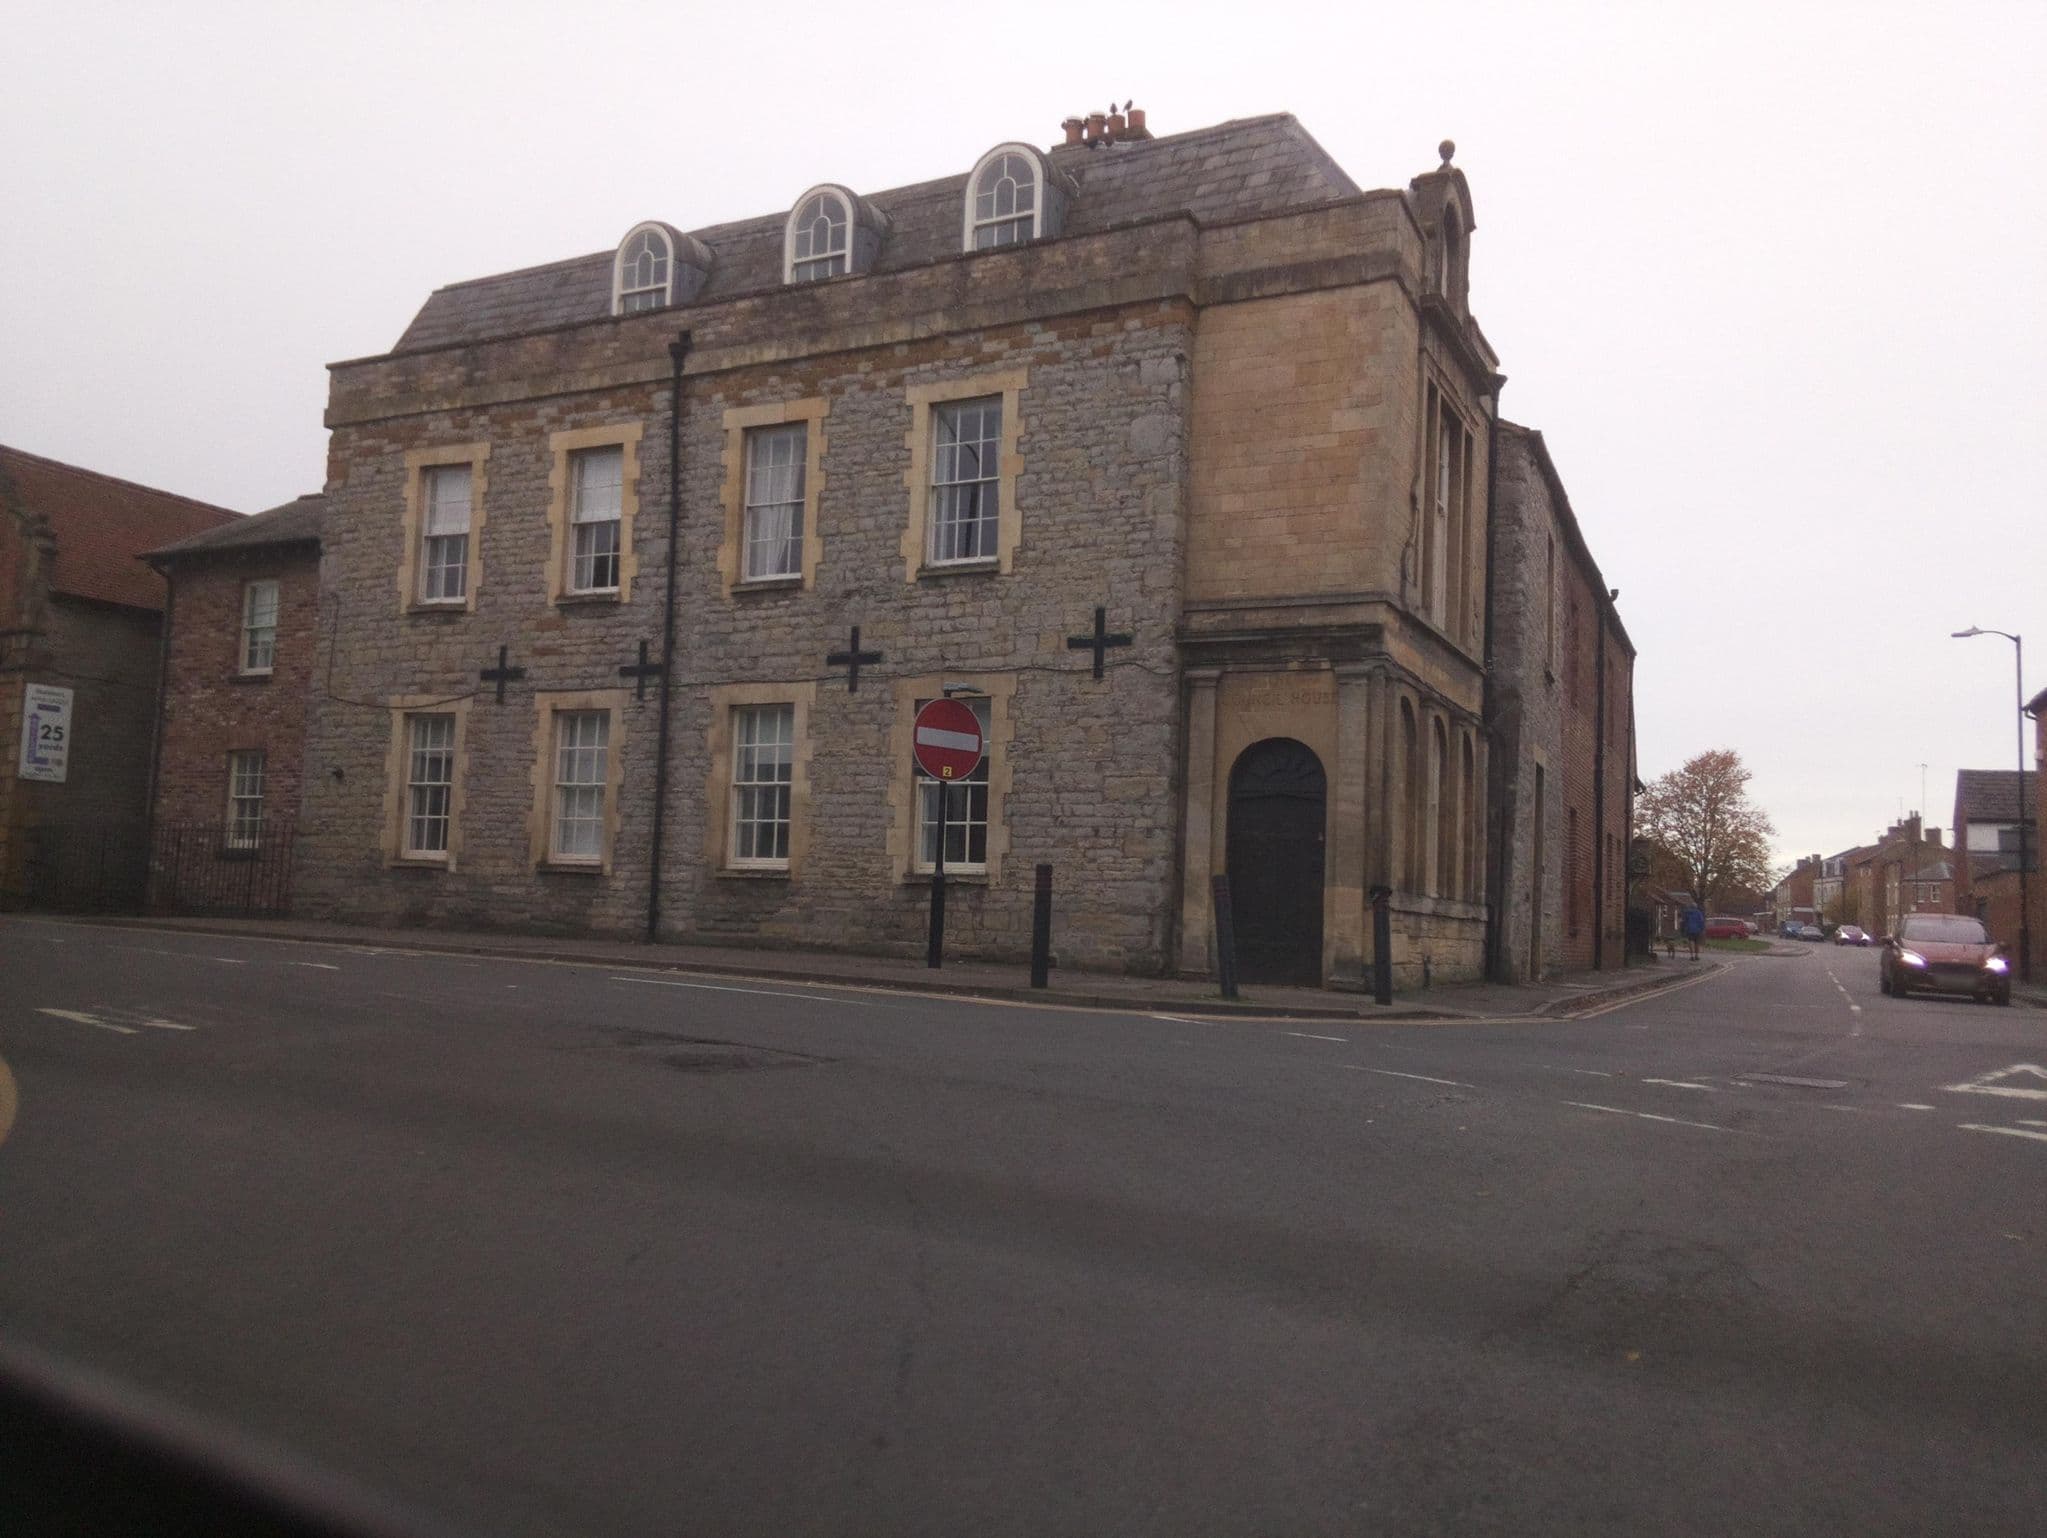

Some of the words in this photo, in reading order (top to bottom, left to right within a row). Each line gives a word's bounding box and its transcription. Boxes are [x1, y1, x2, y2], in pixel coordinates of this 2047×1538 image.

[1221, 693, 1285, 706] OUNCIL
[40, 724, 64, 742] 25
[944, 768, 951, 776] 2
